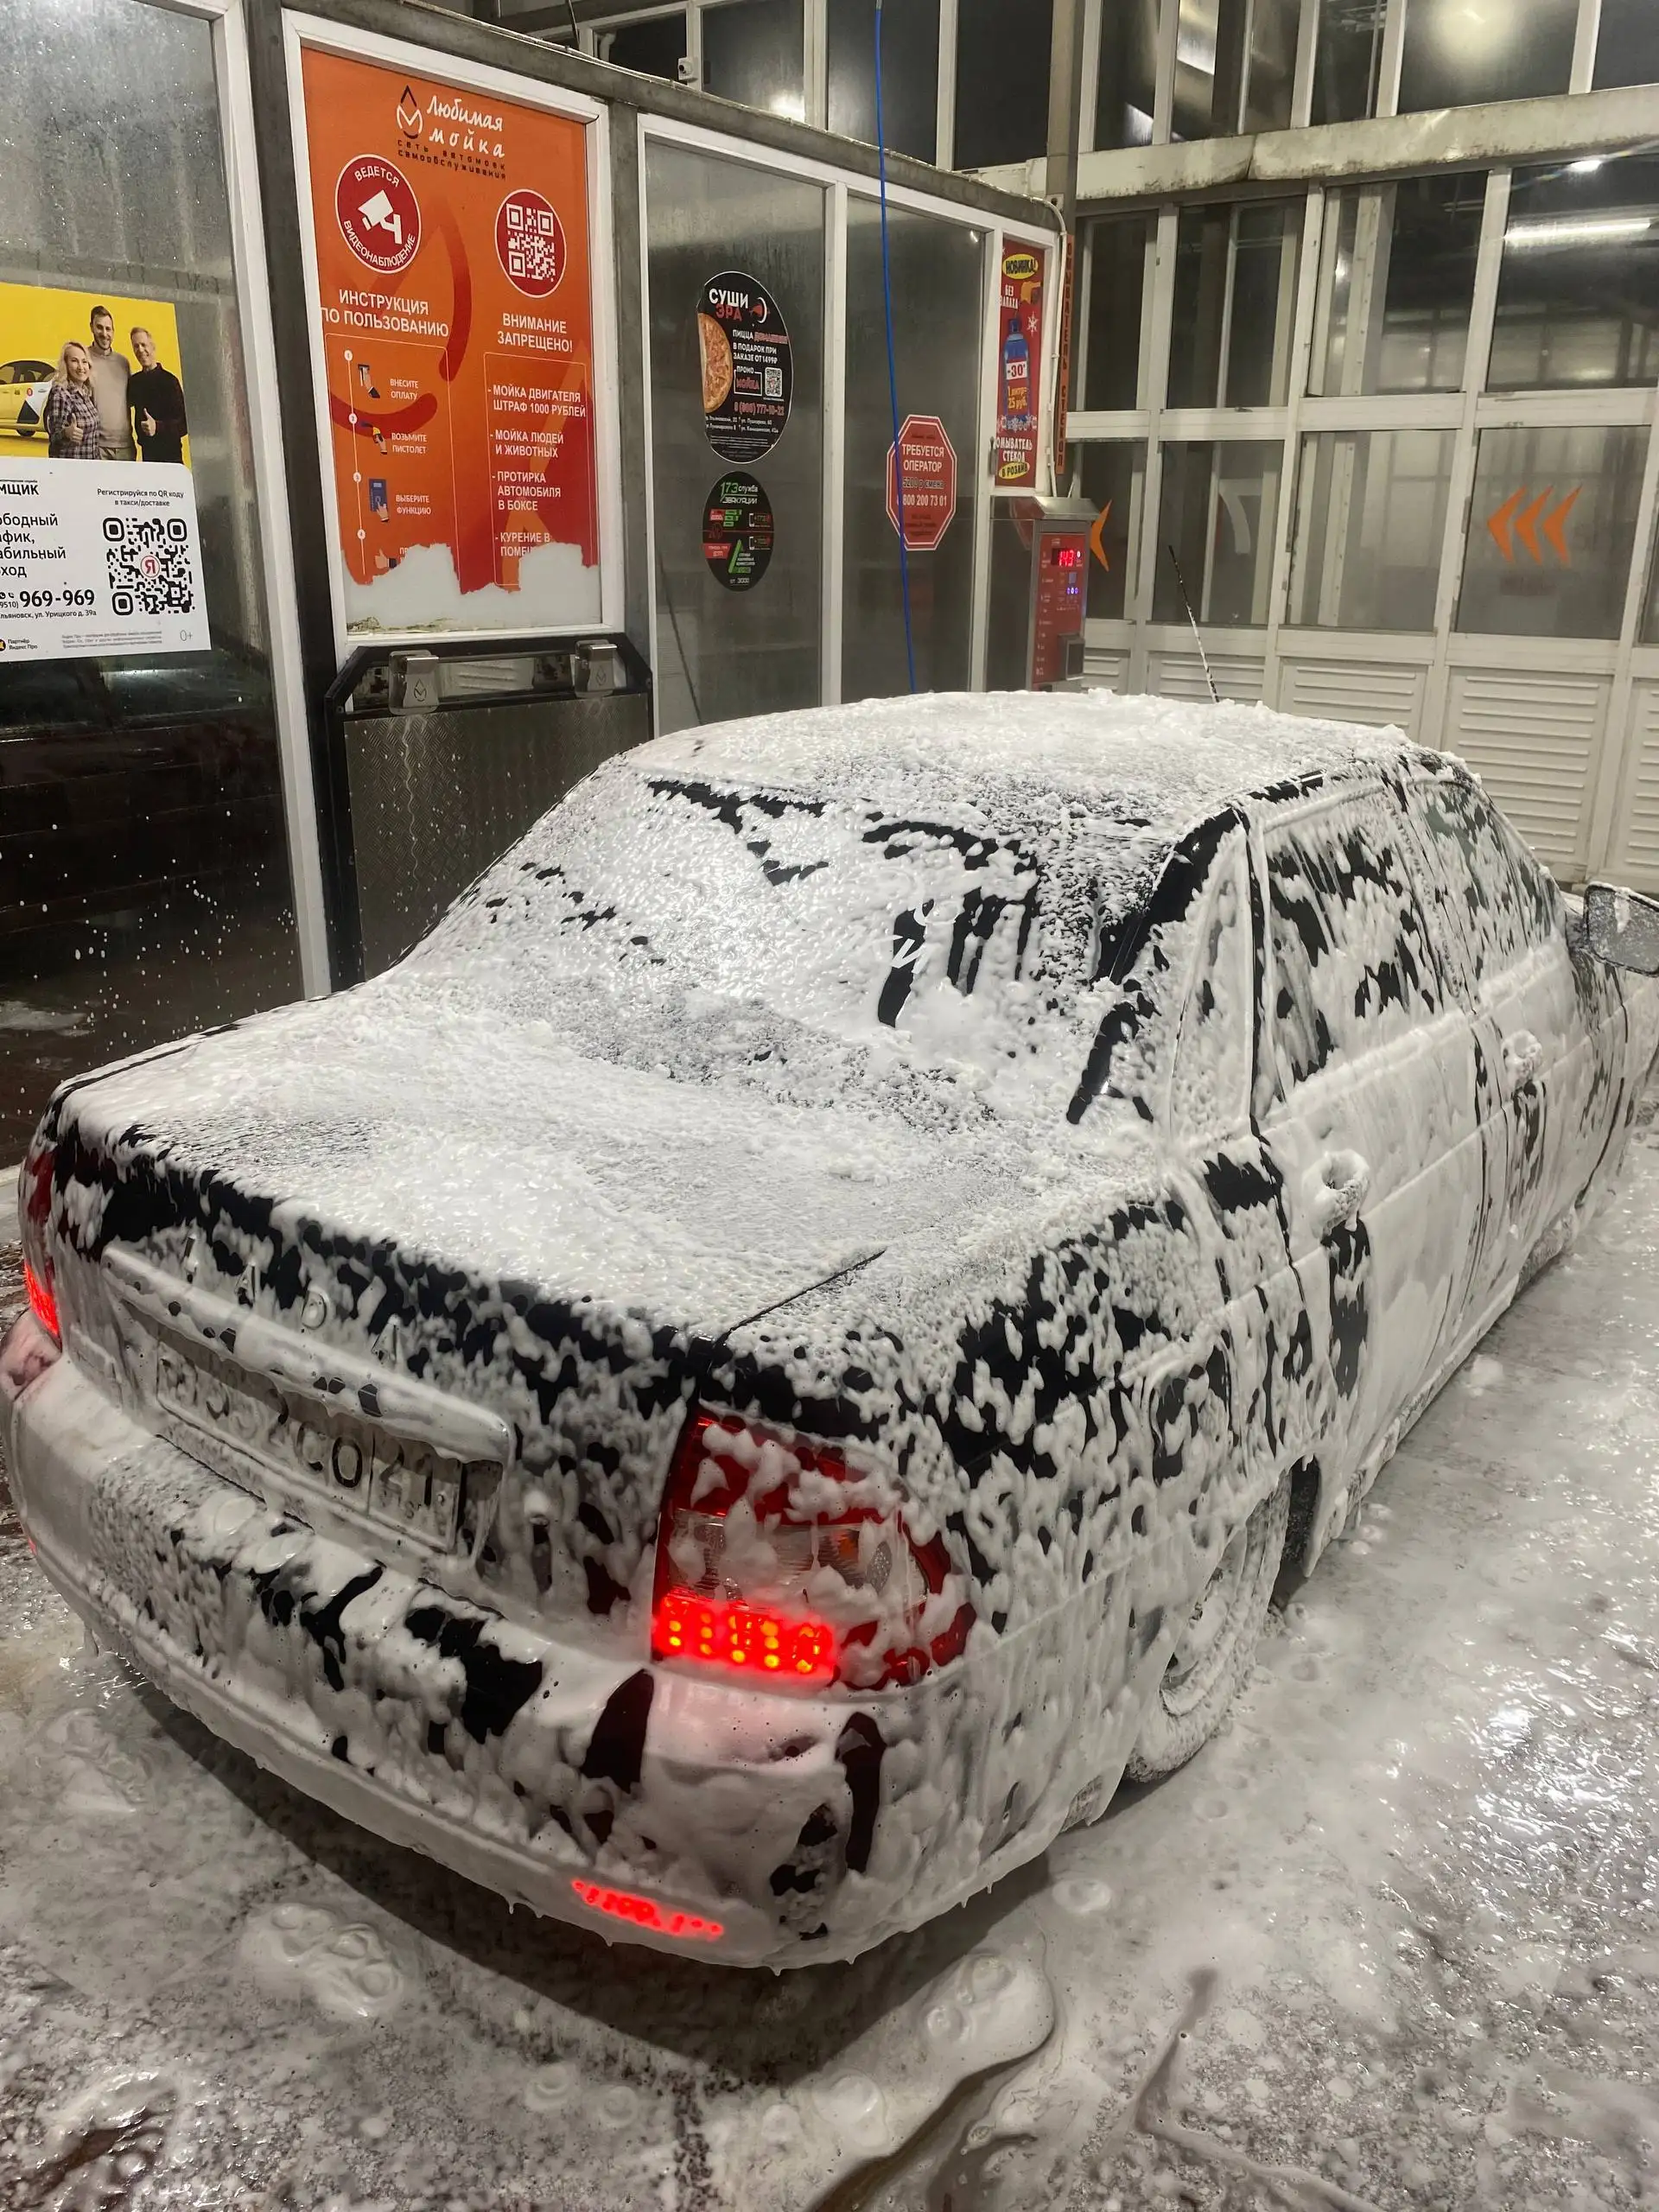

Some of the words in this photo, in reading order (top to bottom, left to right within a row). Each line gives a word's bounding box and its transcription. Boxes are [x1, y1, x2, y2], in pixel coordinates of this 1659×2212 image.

[426, 95, 503, 131] Любимая
[354, 165, 400, 188] ВЕДЕТСЯ
[343, 219, 416, 267] ВИДЕОНАБЛЮДЕНИЕ
[1005, 258, 1036, 275] НОВИНКА!
[339, 289, 429, 315] ИНСТРУКЦИЯ
[709, 288, 748, 309] СУШИ
[715, 303, 742, 321] ЭРА
[321, 307, 340, 323] ПО
[344, 310, 448, 337] ПОЛЬЗОВАНИЮ
[503, 313, 568, 334] ВНИМАНИЕ
[732, 329, 753, 340] ПИЦЦА
[497, 331, 573, 353] ЗАПРЕЩЕНО!
[738, 343, 765, 353] ПОДАРОК
[766, 346, 777, 354] ПРИ
[733, 352, 754, 361] ЗАКАЗЕ
[736, 365, 754, 374] ПРОМО
[390, 378, 419, 389] ВНЕСИТЕ
[391, 391, 417, 401] ОПЛАТУ
[493, 384, 527, 398] МОЙКА
[529, 388, 581, 403] ДВИГАТЕЛЯ
[493, 399, 528, 412] ШТРАФ
[530, 403, 550, 414] 1000
[551, 404, 586, 417] РУБЛЕЙ
[1057, 385, 1067, 467] СТЕКОЛ
[391, 432, 427, 442] ВОЗЬМИТЕ
[495, 428, 529, 442] МОЙКА
[531, 431, 563, 444] ЛЮДЕЙ
[392, 444, 426, 454] ПИСТОЛЕТ
[995, 436, 1033, 450] ОМЫВАТЕЛЬ
[495, 445, 502, 454] И
[505, 445, 558, 458] ЖИВОТНЫХ
[902, 443, 944, 458] ТРЕБУЕТСЯ
[1002, 450, 1026, 462] СТЕКОЛ
[903, 460, 943, 473] ОПЕРАТОР
[497, 471, 546, 483] ПРОТИРКА
[97, 488, 148, 498] Регистрируйся
[157, 490, 168, 499] QR
[396, 494, 429, 503] ВЫБЕРИТЕ
[498, 486, 561, 498] АВТОМОБИЛЯ
[498, 500, 505, 511] В
[507, 500, 538, 511] БОКСЕ
[902, 493, 915, 505] 800
[916, 494, 929, 506] 200
[930, 495, 938, 506] 73
[939, 495, 947, 506] 01
[397, 506, 431, 515] ФУНКЦИЮ
[500, 532, 542, 543] КУРЕНИЕ
[543, 532, 550, 543] В
[19, 589, 95, 607] 969-969
[180, 630, 193, 641] 0+
